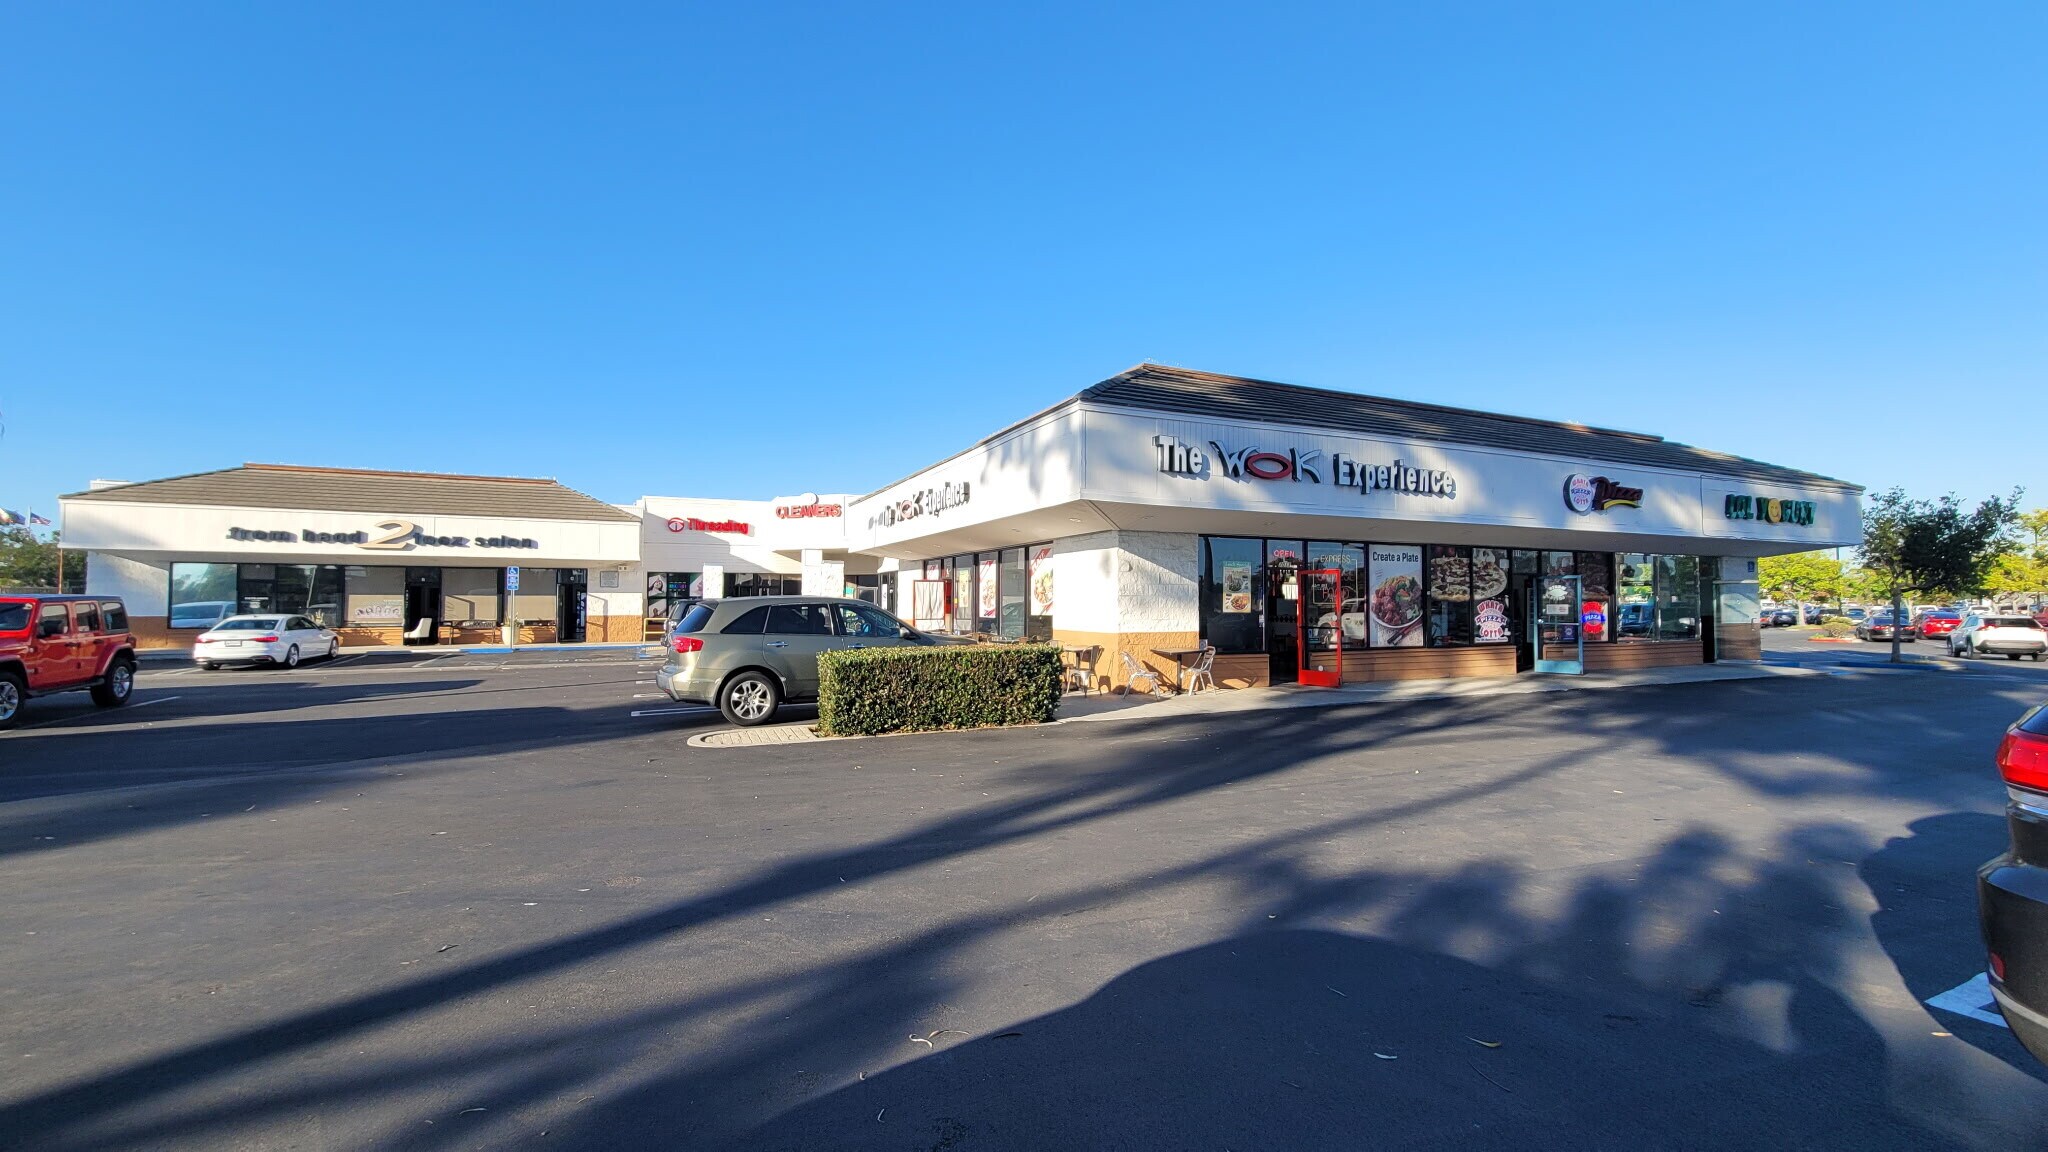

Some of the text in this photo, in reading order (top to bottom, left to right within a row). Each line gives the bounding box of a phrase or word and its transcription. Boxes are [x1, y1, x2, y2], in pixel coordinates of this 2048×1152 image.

[1153, 436, 1203, 474] The
[1334, 452, 1456, 496] Experience
[1589, 476, 1643, 511] Pizza
[776, 504, 842, 519] CLEANERS
[228, 526, 297, 543] from
[302, 529, 368, 545] head
[357, 519, 418, 550] 2
[475, 534, 538, 549] salon
[687, 518, 749, 535] Threading
[1273, 549, 1295, 558] OPEN
[1320, 554, 1351, 564] EXPRESS
[1372, 551, 1419, 562] Create a Plate
